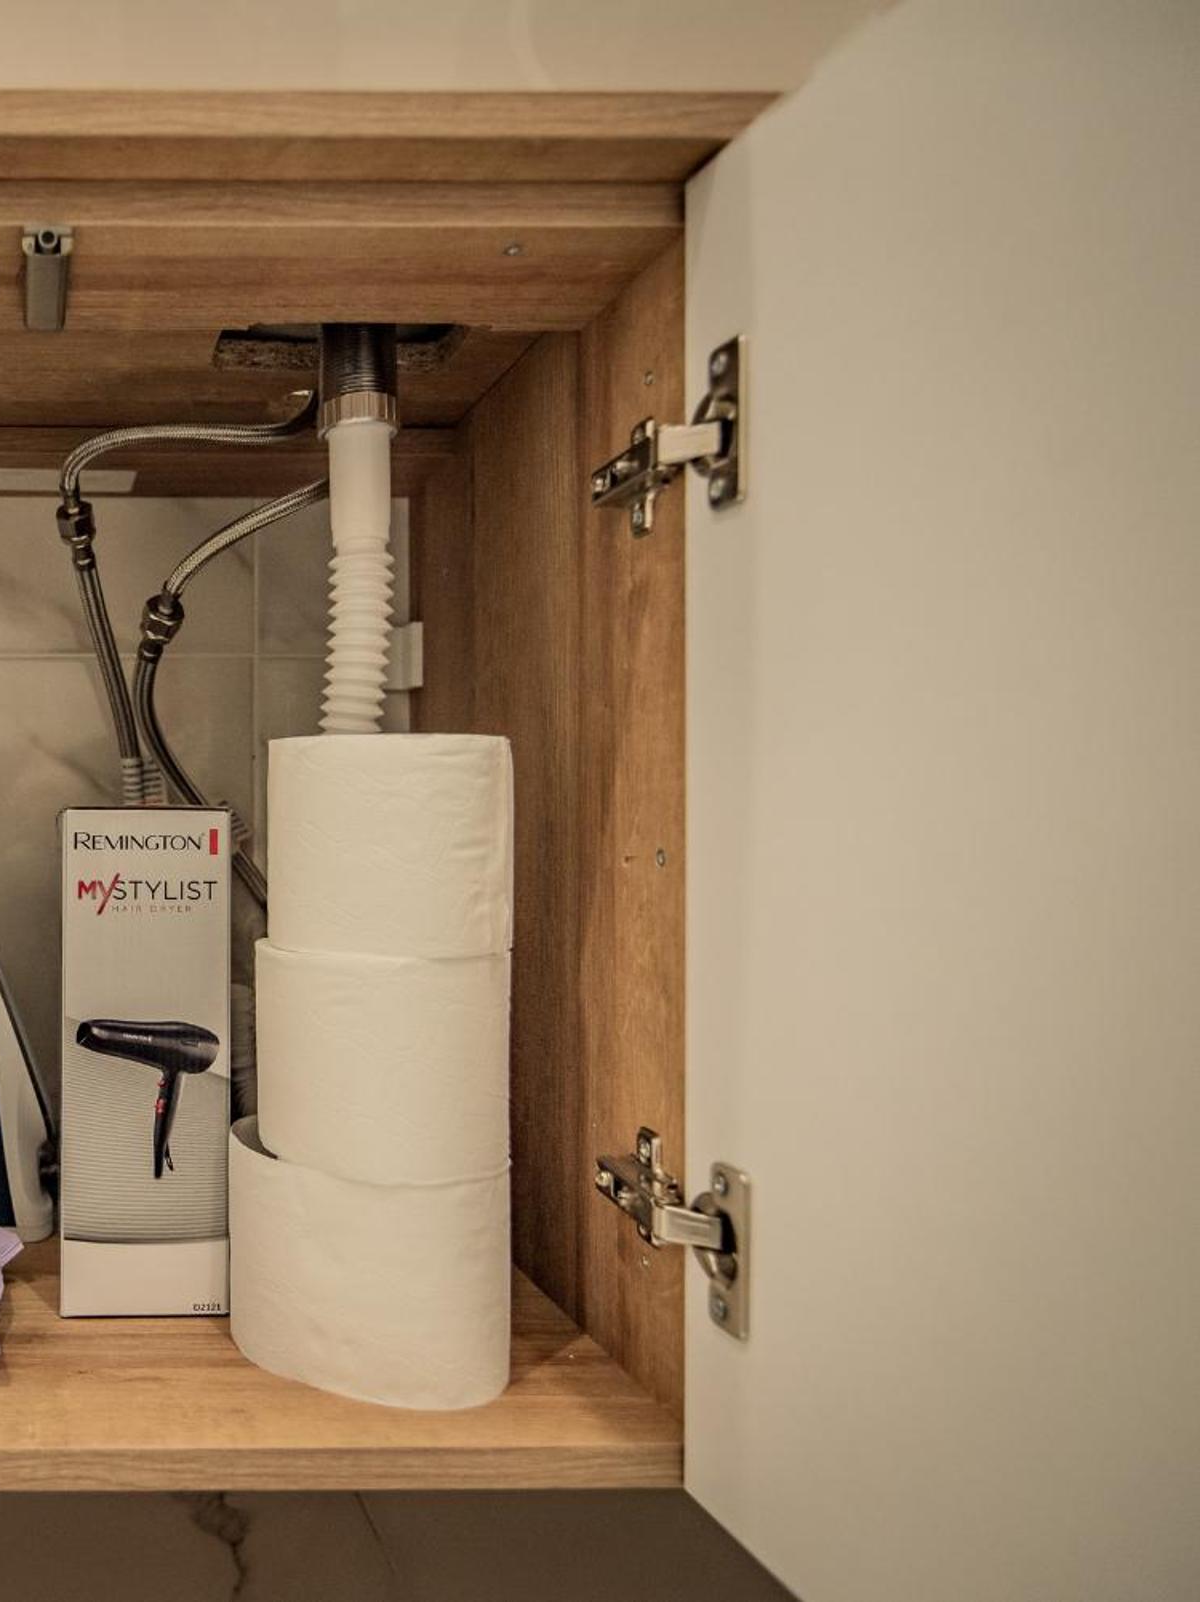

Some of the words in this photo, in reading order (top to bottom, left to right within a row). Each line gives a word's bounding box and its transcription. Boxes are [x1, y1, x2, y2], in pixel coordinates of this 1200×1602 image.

[74, 832, 201, 850] REMINGTON
[112, 904, 141, 912] HAIR
[151, 904, 191, 913] DRYER
